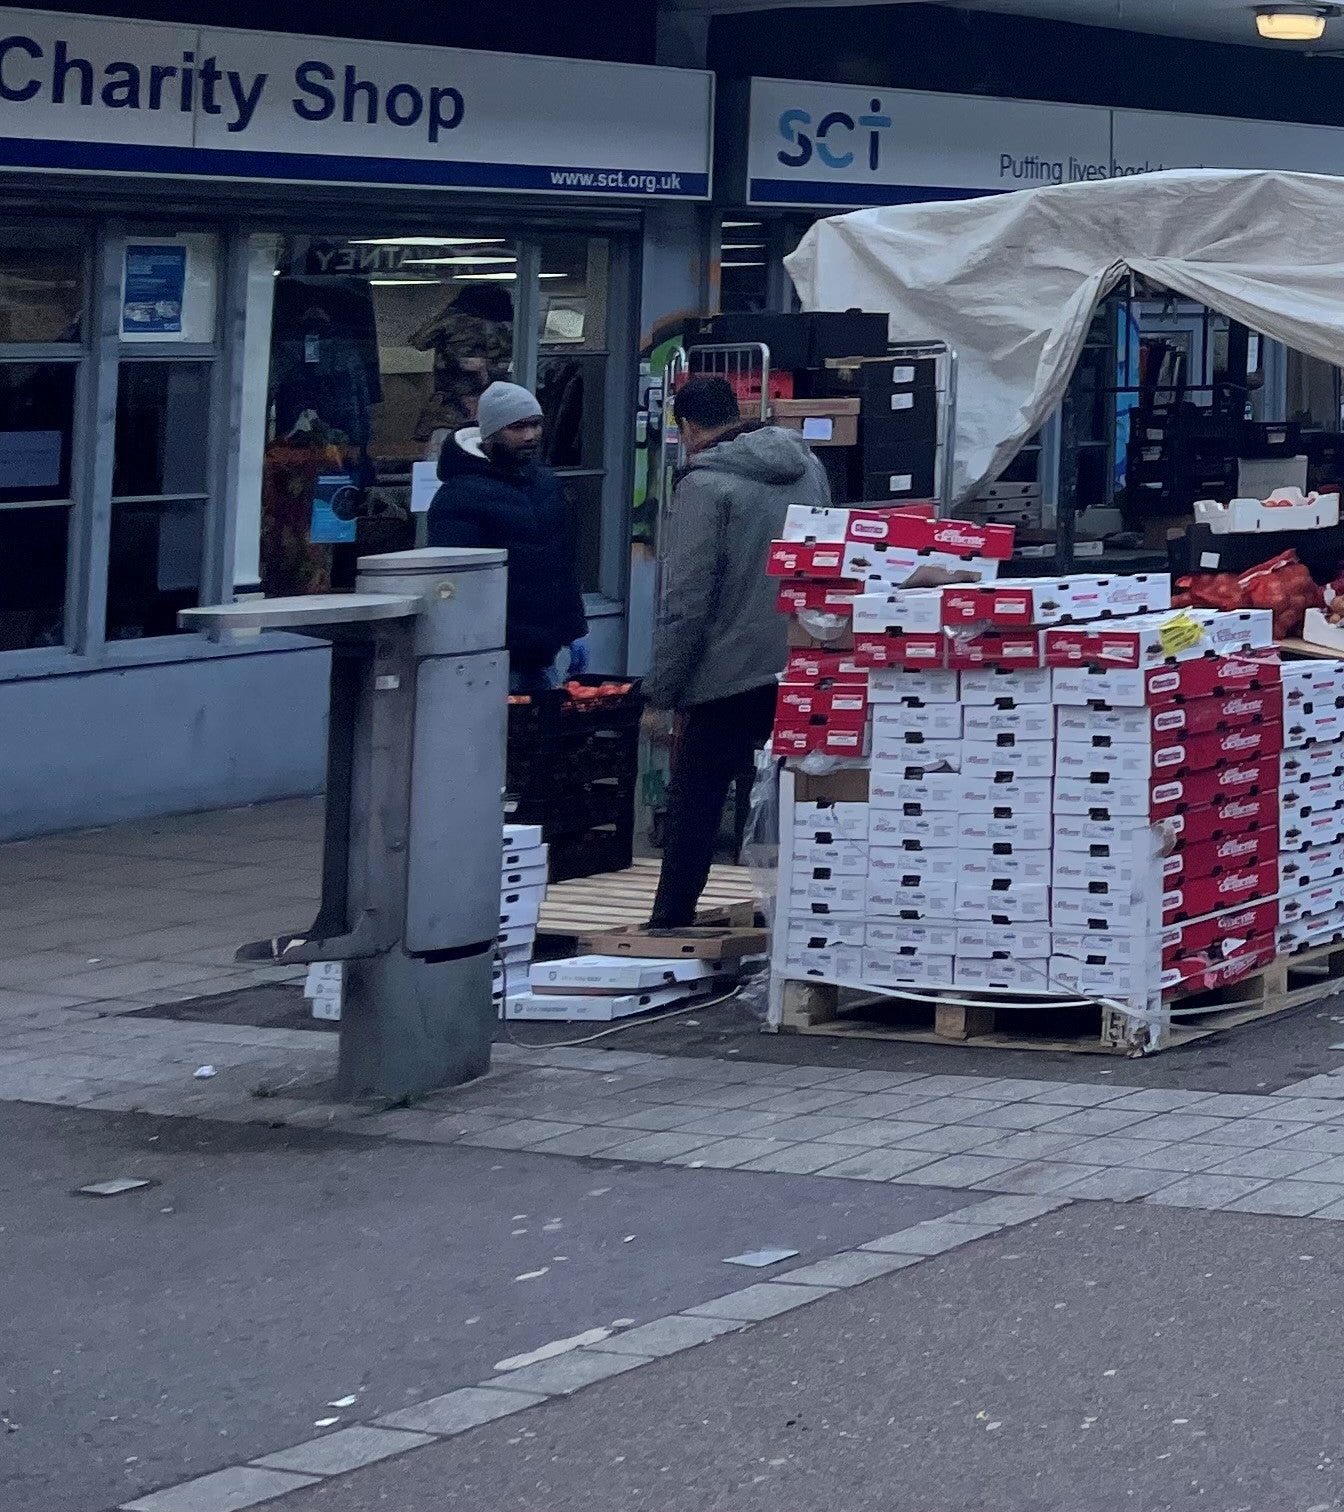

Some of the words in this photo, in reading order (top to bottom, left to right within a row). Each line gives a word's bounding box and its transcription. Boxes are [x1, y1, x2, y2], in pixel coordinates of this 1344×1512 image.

[0, 35, 267, 133] Charity
[292, 60, 466, 144] Shop
[550, 169, 681, 193] www.sct.org.uk
[1000, 154, 1063, 184] Putting
[1068, 156, 1107, 180] lives
